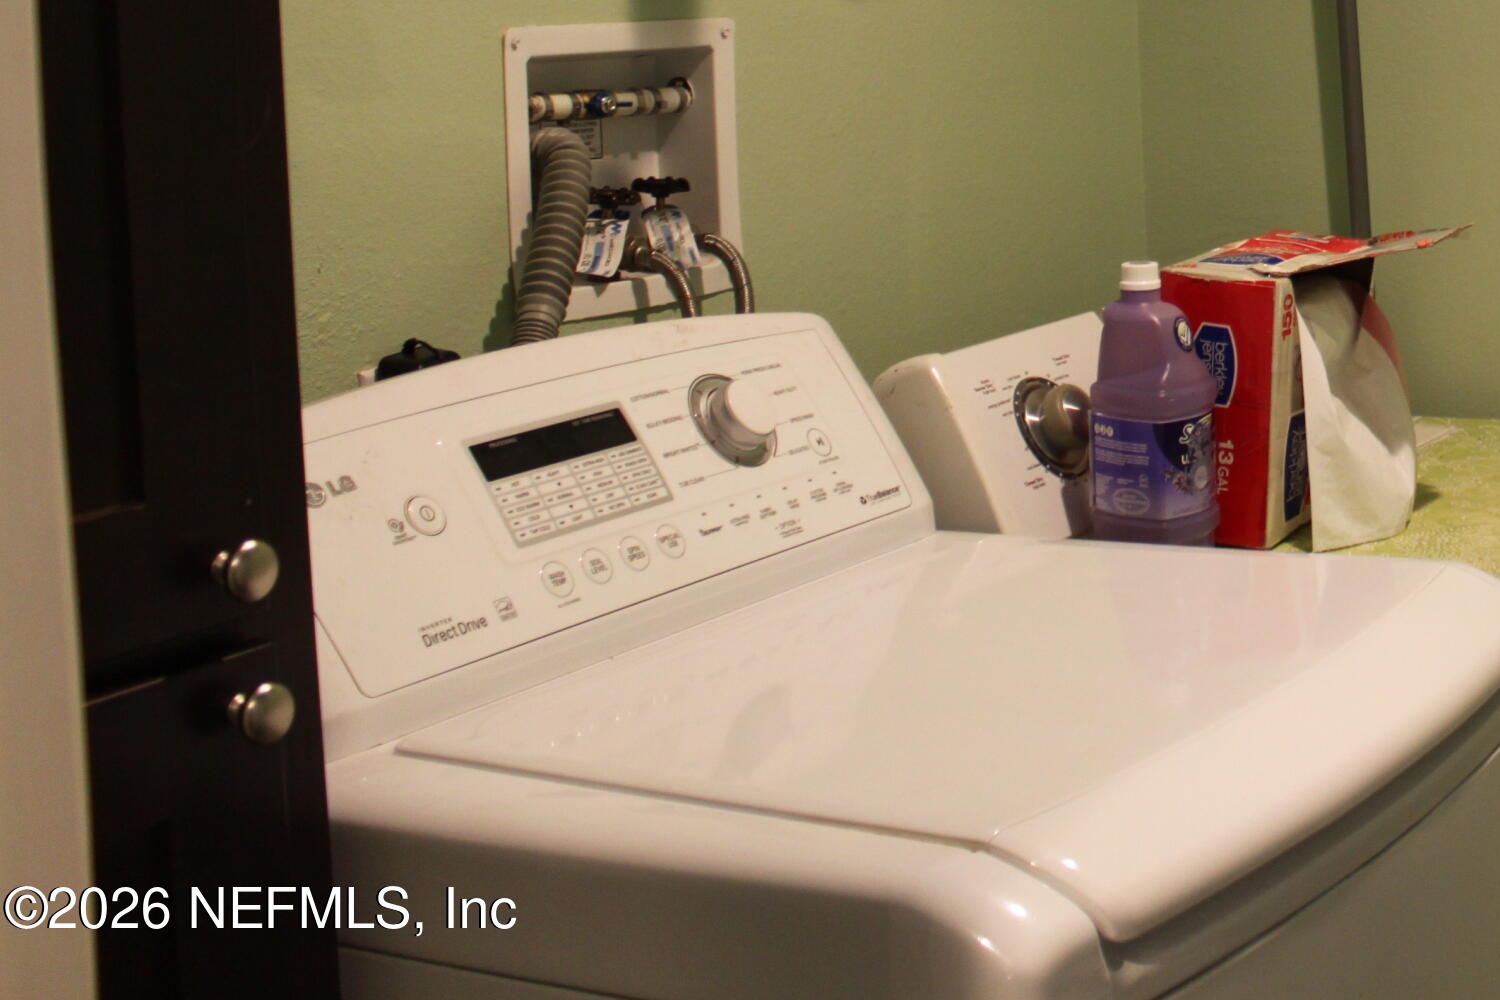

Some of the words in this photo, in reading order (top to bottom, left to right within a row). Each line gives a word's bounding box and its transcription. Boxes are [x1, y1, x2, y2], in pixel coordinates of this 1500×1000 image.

[1282, 293, 1294, 341] 150
[1218, 439, 1235, 465] 13
[325, 474, 359, 498] LG
[1217, 466, 1230, 495] GAL
[421, 625, 460, 648] Direct
[456, 616, 489, 636] Drive
